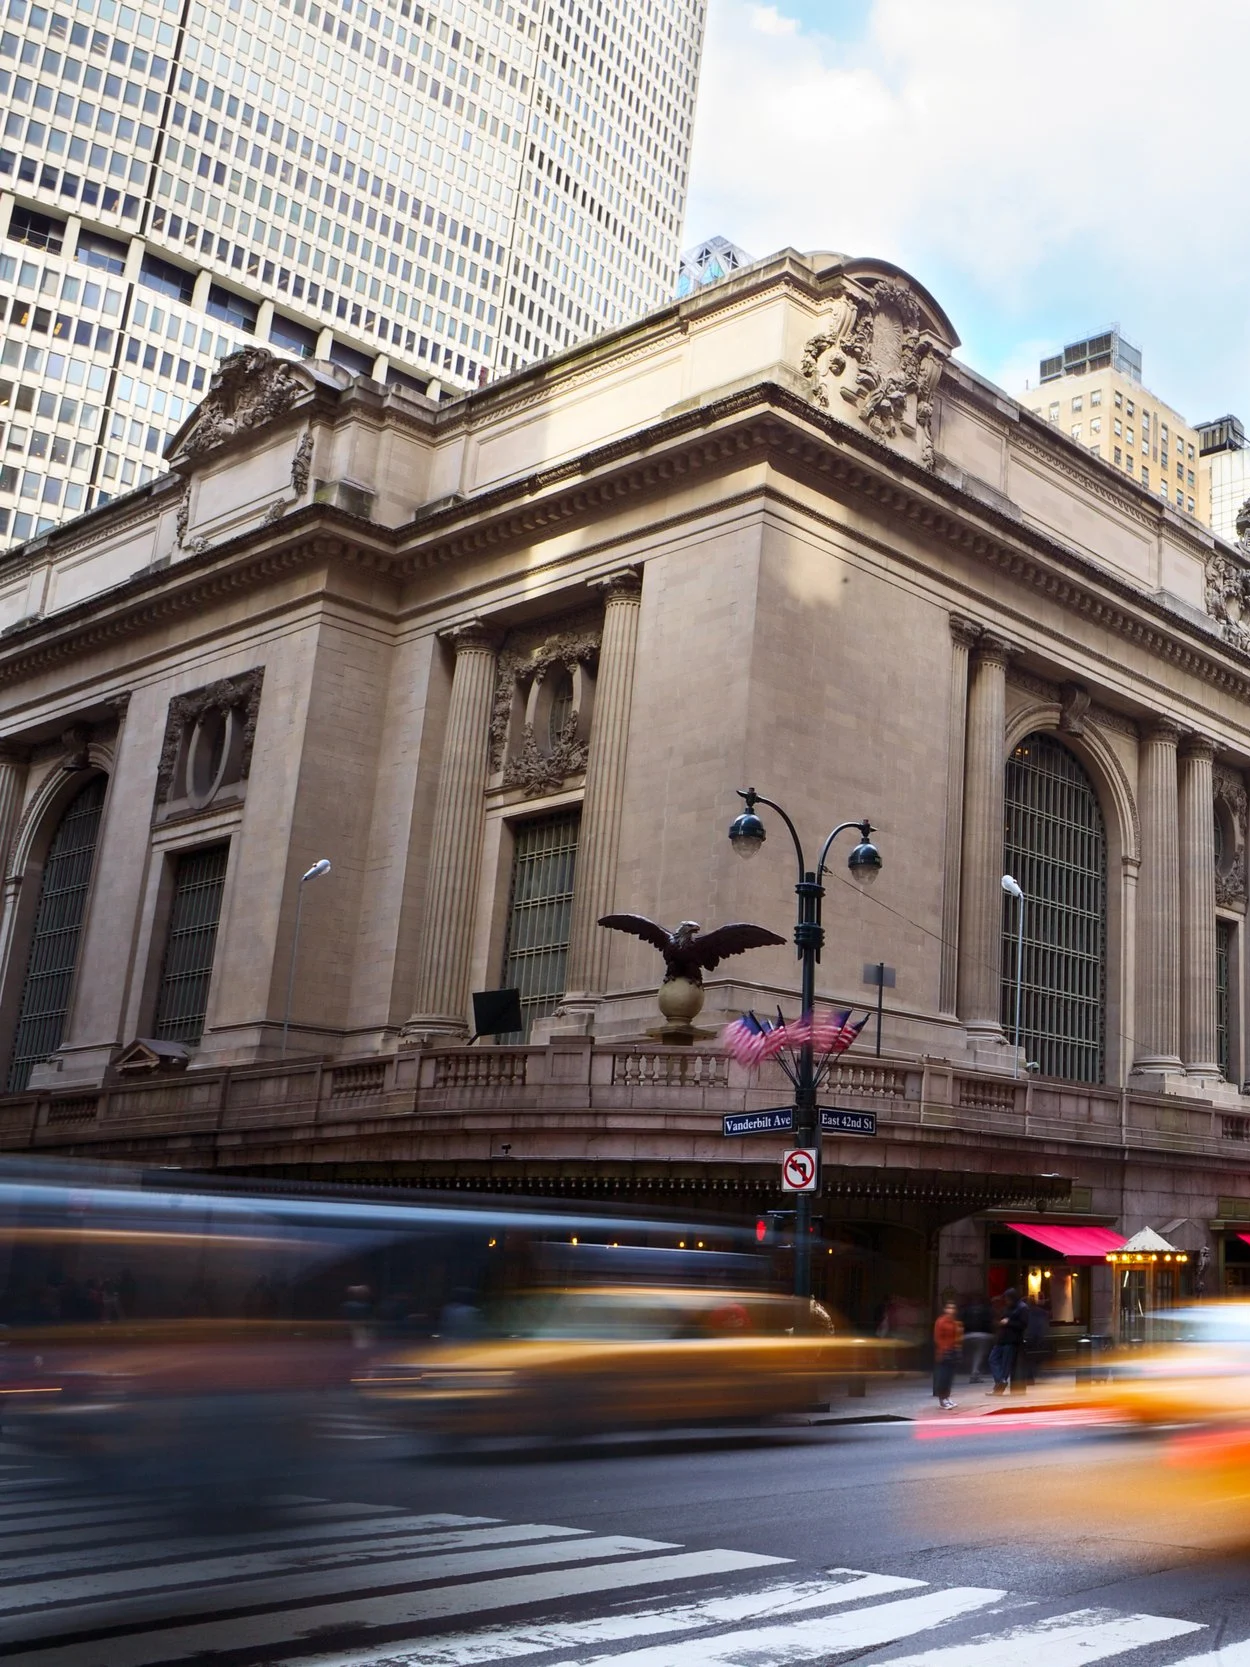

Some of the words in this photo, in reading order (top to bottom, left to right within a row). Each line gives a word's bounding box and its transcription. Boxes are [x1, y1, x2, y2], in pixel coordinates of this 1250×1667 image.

[726, 1117, 771, 1131] Vanderbilt
[774, 1115, 791, 1126] Ave
[821, 1113, 840, 1126] East
[842, 1117, 861, 1128] 42nd
[863, 1118, 873, 1129] St
